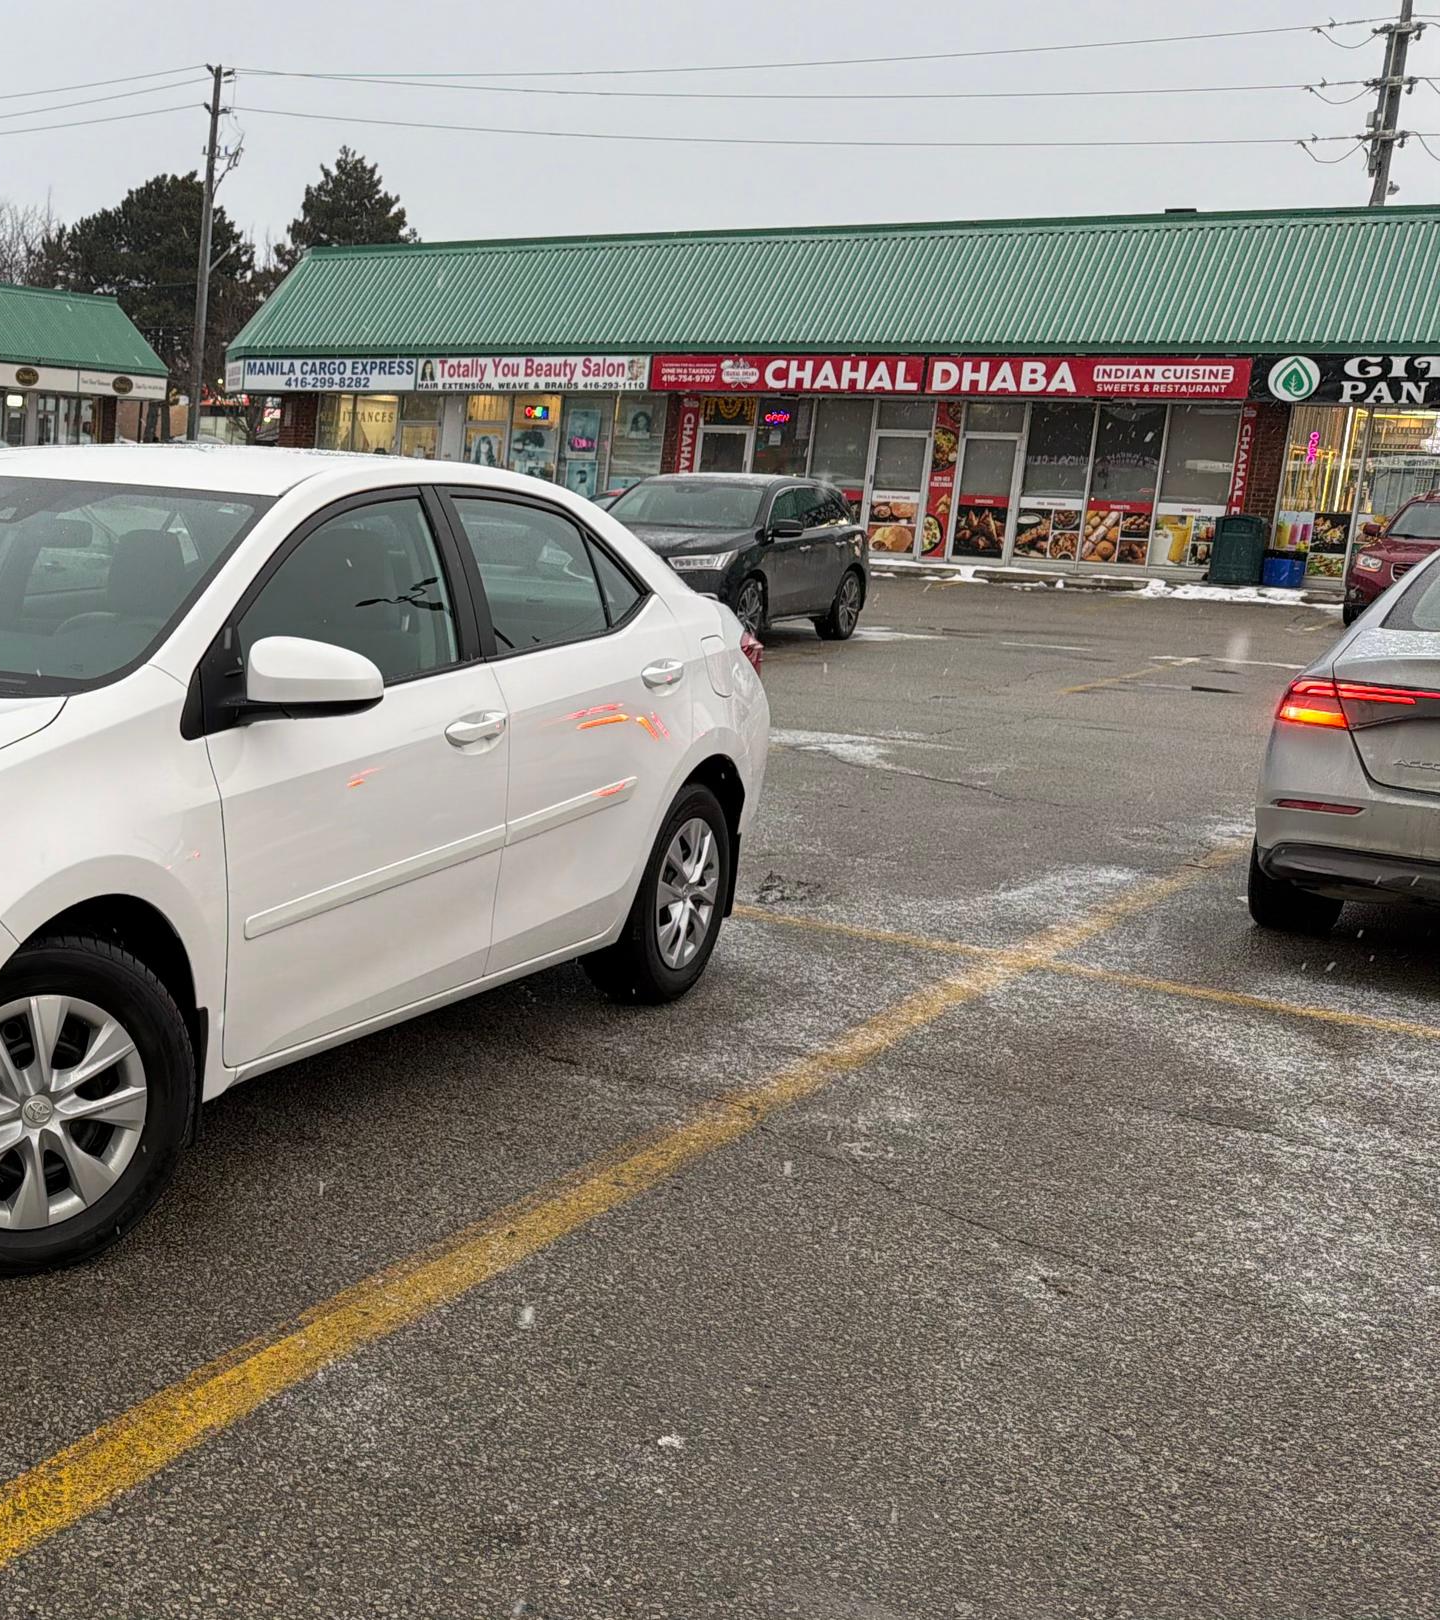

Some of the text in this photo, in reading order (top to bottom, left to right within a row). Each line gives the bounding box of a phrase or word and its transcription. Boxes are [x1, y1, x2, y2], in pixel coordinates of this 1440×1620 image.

[246, 361, 296, 376] MANILA
[300, 361, 347, 375] CARGO
[351, 360, 414, 375] EXPRESS
[439, 357, 626, 382] Totally You Beauty Salon
[1095, 368, 1231, 380] INDIAN CUISINE
[285, 377, 370, 388] 416-299-8282
[764, 360, 1077, 393] CHAHAL DHABA
[418, 382, 439, 390] HAIR
[1096, 383, 1227, 393] SWEETS & RESTAURANT
[1338, 381, 1430, 403] PAN
[765, 413, 790, 424] OPEN
[679, 413, 695, 473] CHAHA
[1231, 424, 1252, 502] CHAHAL
